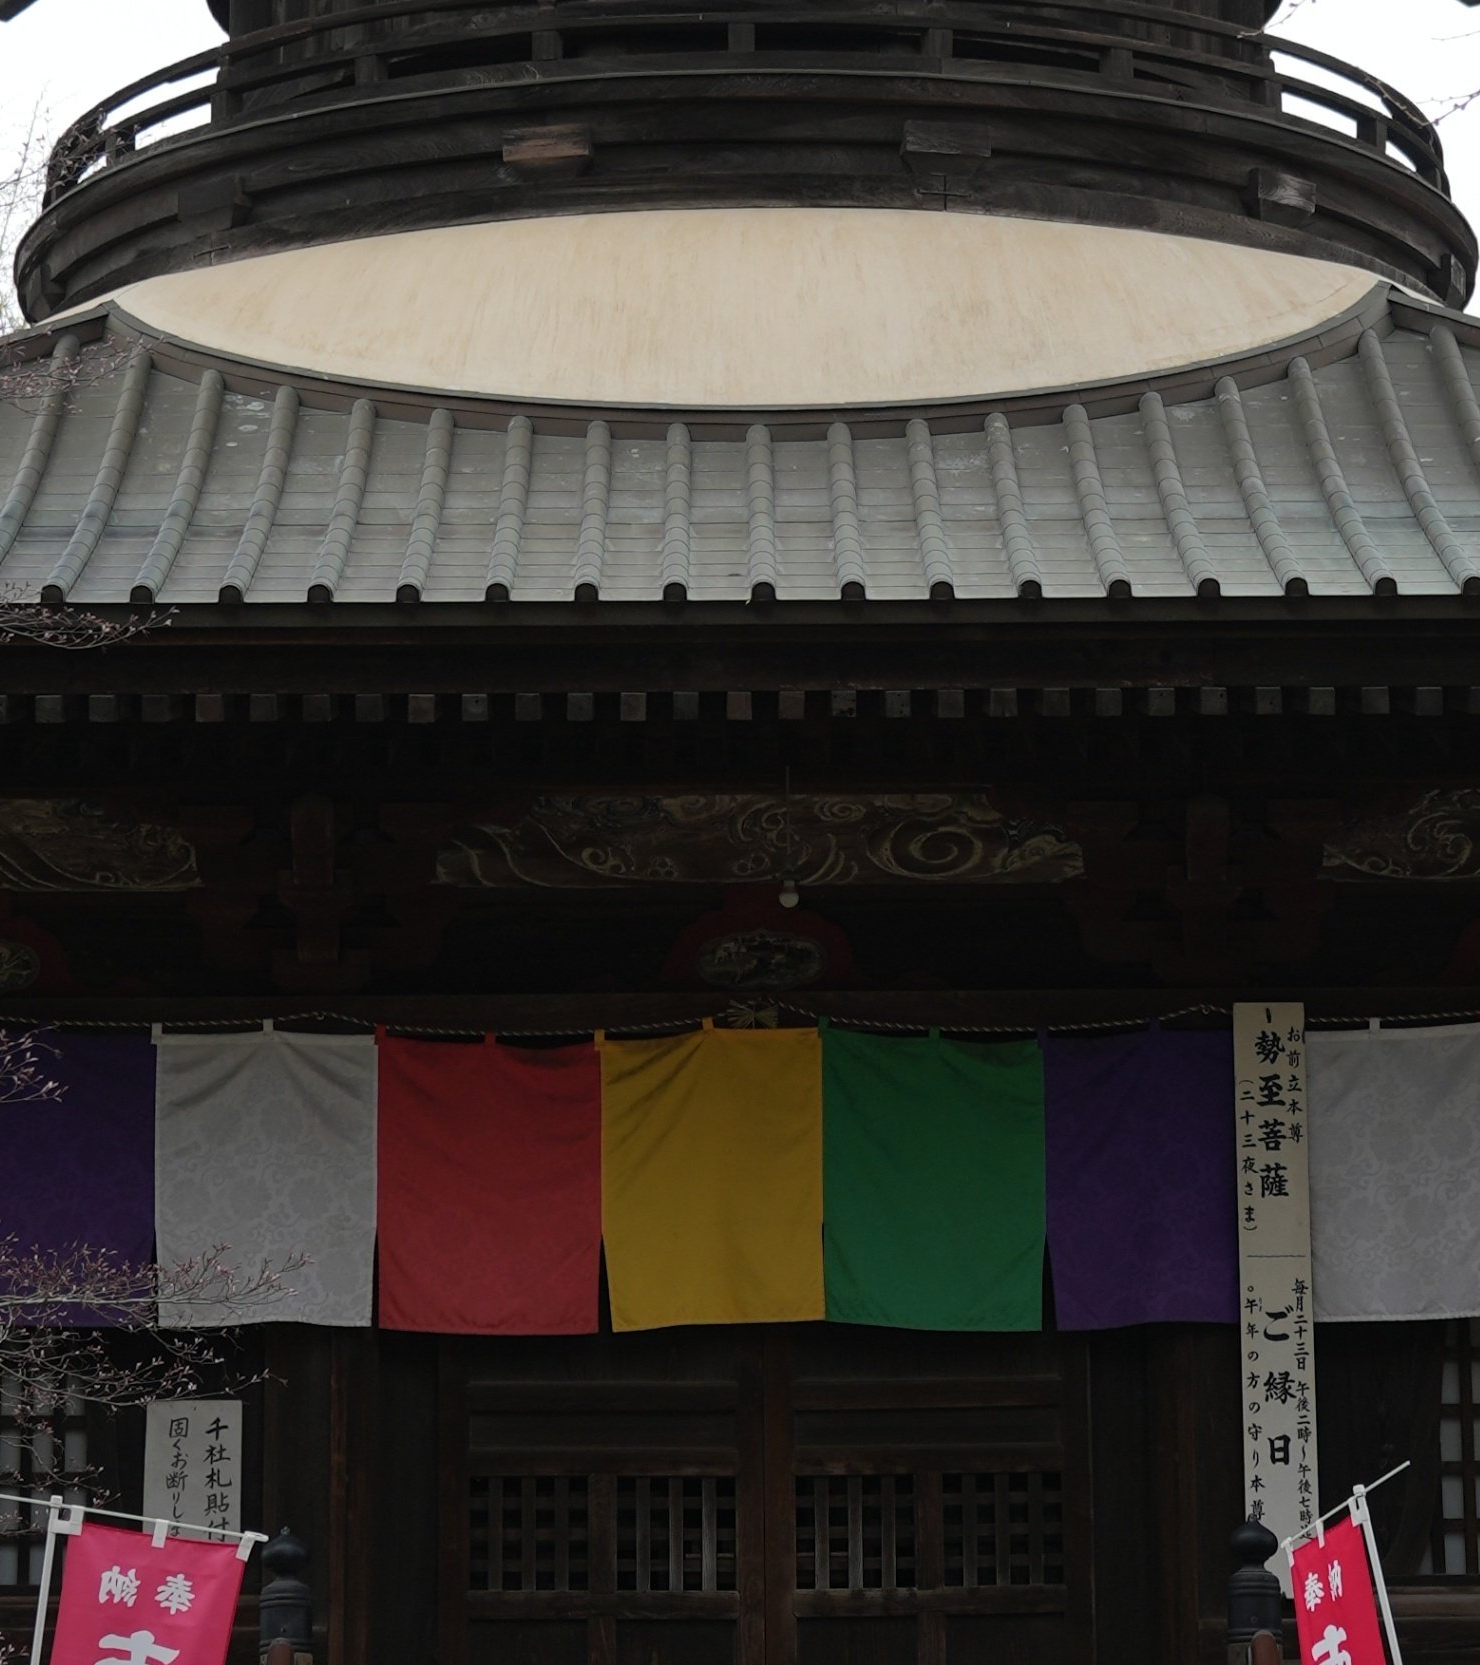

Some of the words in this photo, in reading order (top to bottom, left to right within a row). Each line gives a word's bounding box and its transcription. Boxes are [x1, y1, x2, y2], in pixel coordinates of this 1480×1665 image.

[1255, 1030, 1289, 1198] 勢至菩薩
[1263, 1306, 1297, 1465] ご縁日
[1291, 1278, 1309, 1372] 毎月二十三日
[204, 1417, 232, 1542] 千社札貼付
[1305, 1558, 1343, 1612] 奉納
